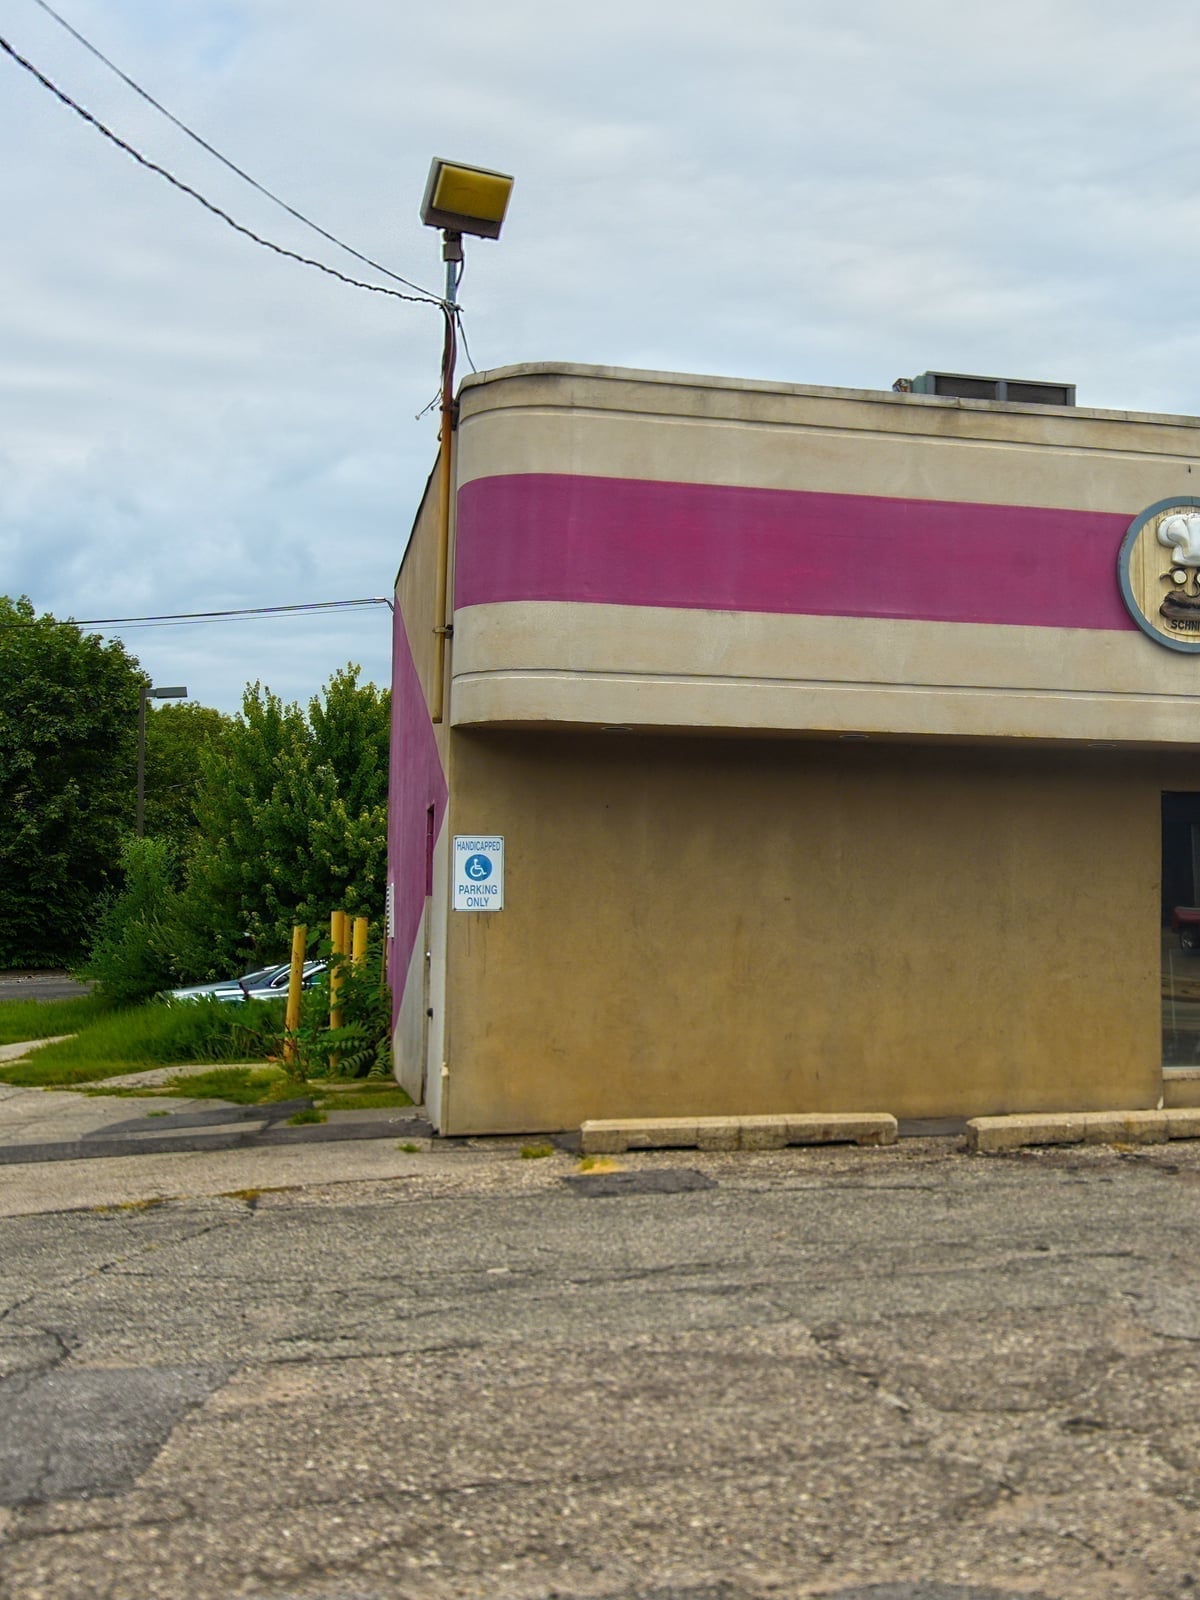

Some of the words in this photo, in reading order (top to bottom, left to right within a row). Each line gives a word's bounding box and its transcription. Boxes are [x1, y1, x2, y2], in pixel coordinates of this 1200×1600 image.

[457, 841, 500, 851] HANDICAPPED
[459, 885, 497, 894] PARKING
[466, 897, 490, 907] ONLY
